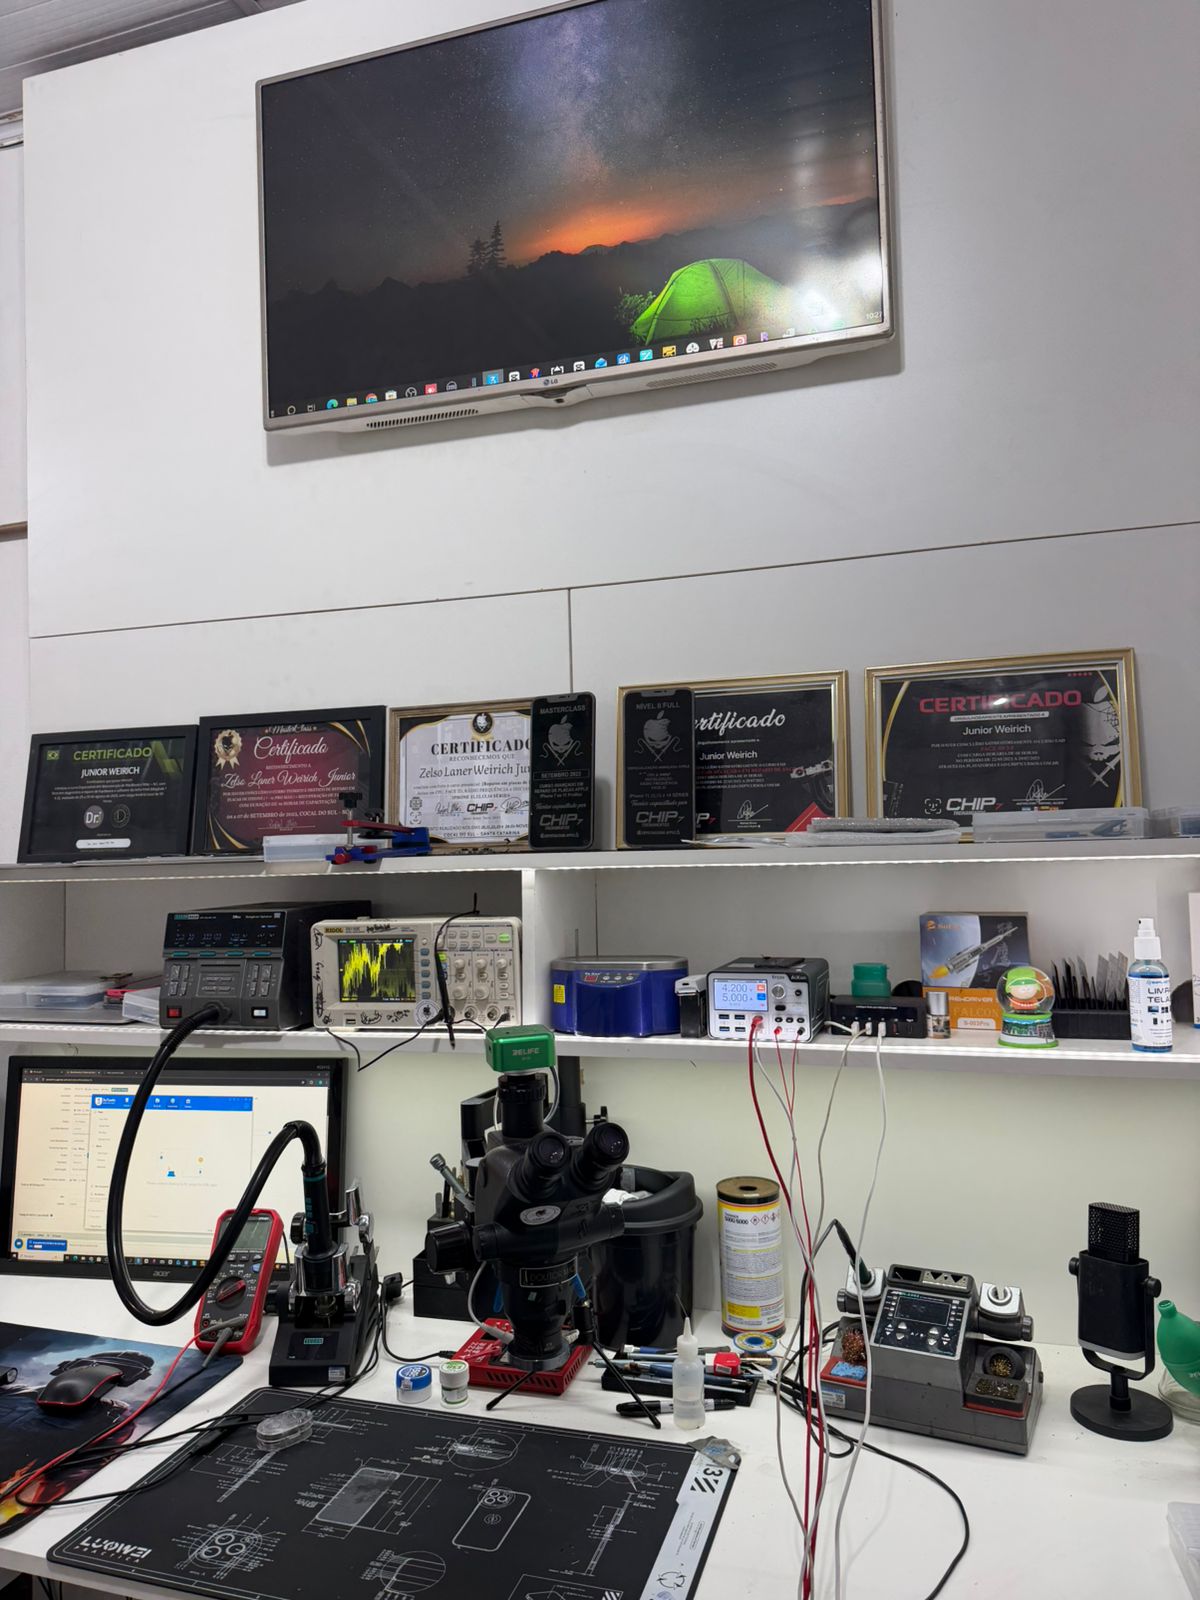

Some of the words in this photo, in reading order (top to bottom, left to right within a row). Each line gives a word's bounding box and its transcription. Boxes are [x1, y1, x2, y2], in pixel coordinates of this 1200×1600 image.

[540, 705, 586, 714] MASTERCLASS
[962, 726, 993, 736] Junior
[994, 723, 1032, 734] Weirich
[73, 747, 152, 761] CERTIFICADO
[254, 736, 328, 763] Certificado
[699, 752, 726, 761] Junior
[726, 750, 758, 760] Weirich
[81, 767, 108, 778] JUNIOR
[108, 766, 140, 777] WEIRICH
[277, 769, 318, 786] Weirich
[318, 767, 356, 788] Junior
[419, 767, 443, 779] Zelso
[444, 765, 473, 777] Laner
[473, 763, 513, 775] Weirich
